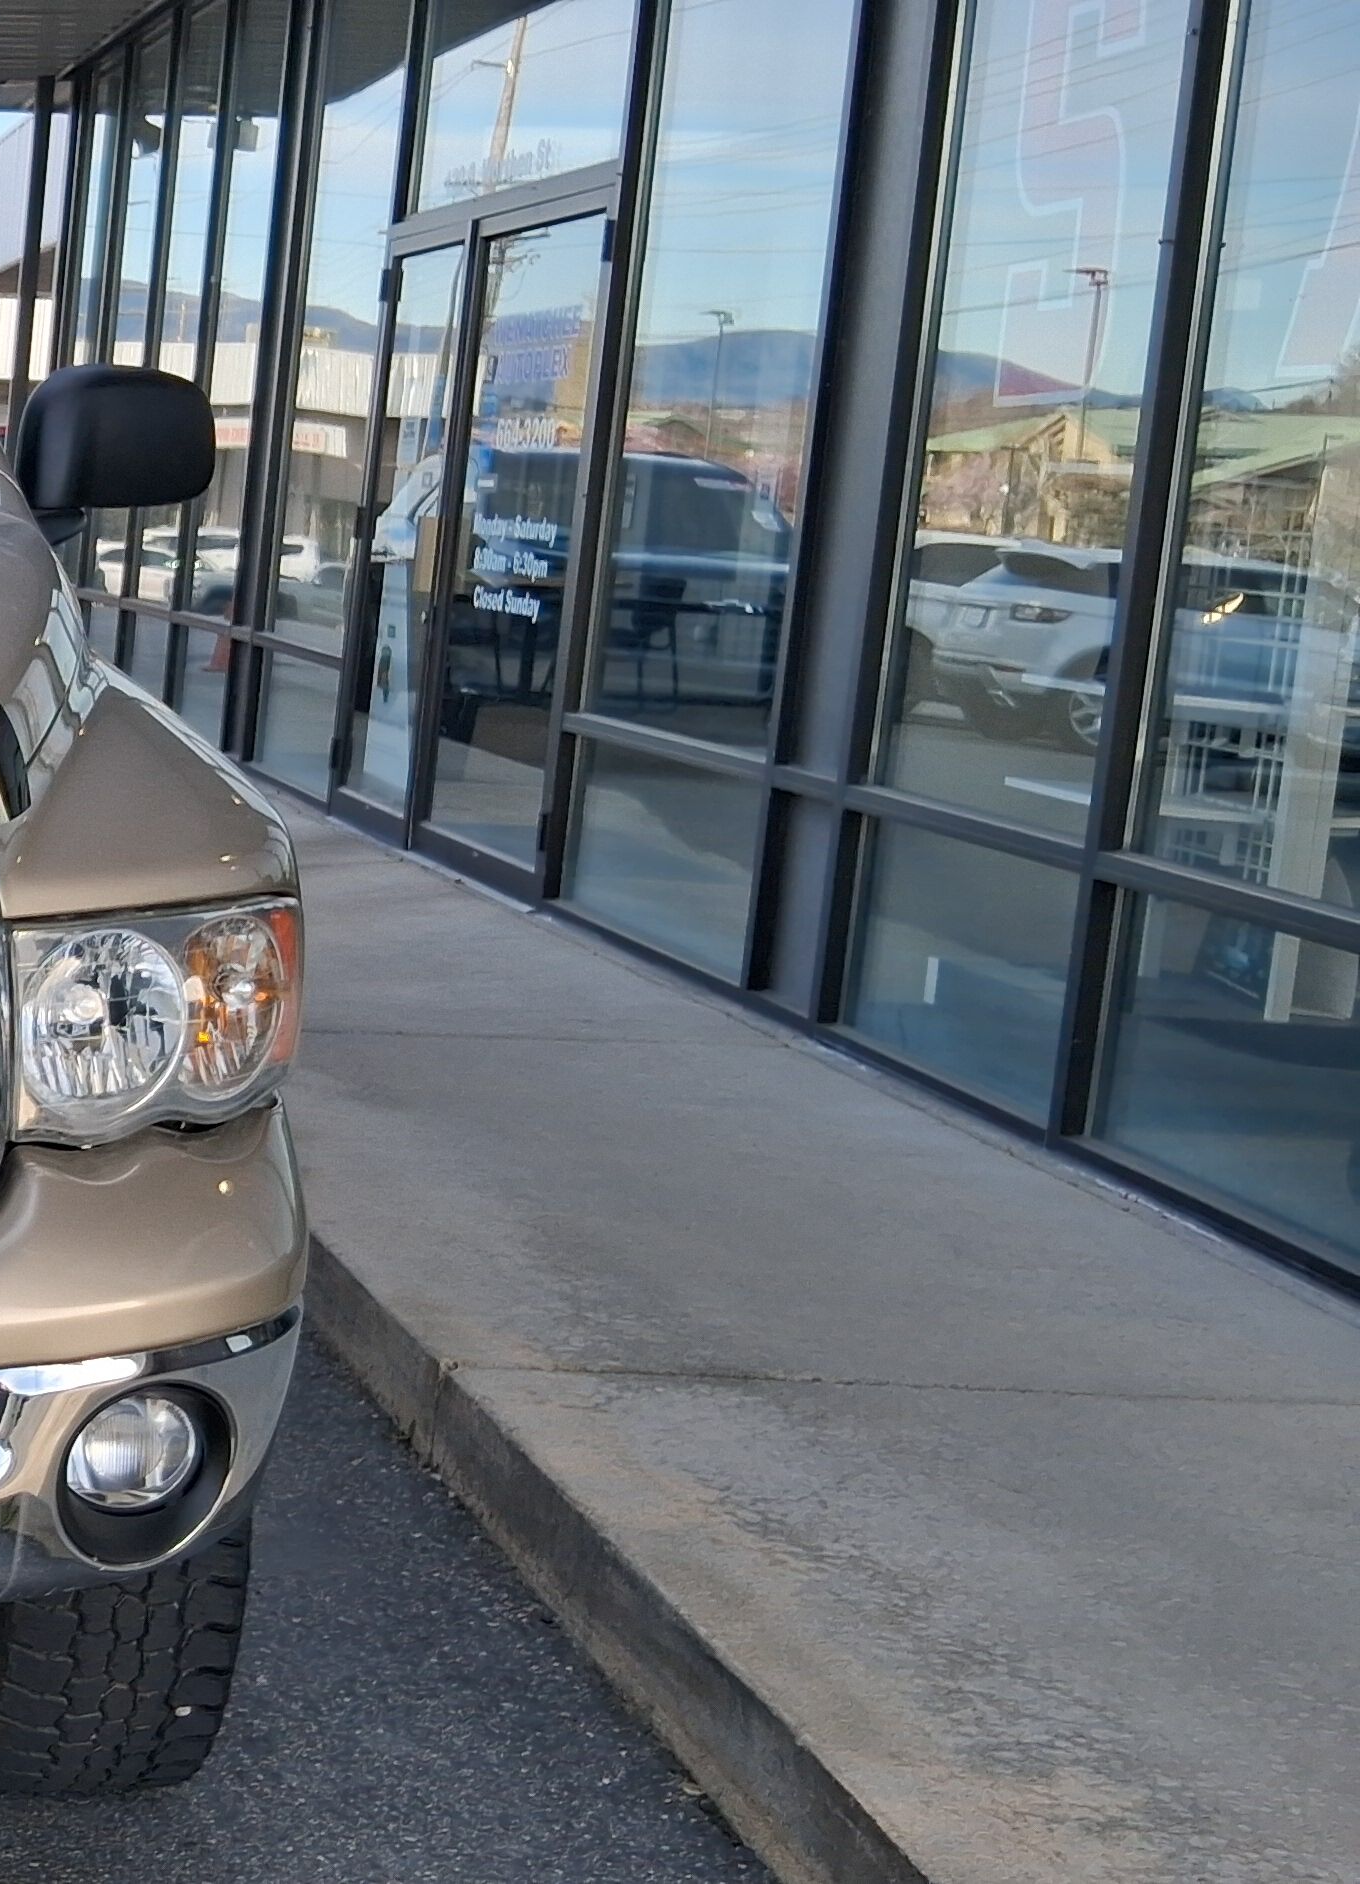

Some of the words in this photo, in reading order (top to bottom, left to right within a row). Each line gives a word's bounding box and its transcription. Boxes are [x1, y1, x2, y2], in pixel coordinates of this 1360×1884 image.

[495, 414, 556, 452] 664-3200
[473, 512, 508, 542] Monday
[513, 514, 558, 548] Saturday
[512, 551, 548, 583] 6:30pm
[473, 585, 505, 612] Closed
[505, 589, 540, 624] Sunday
